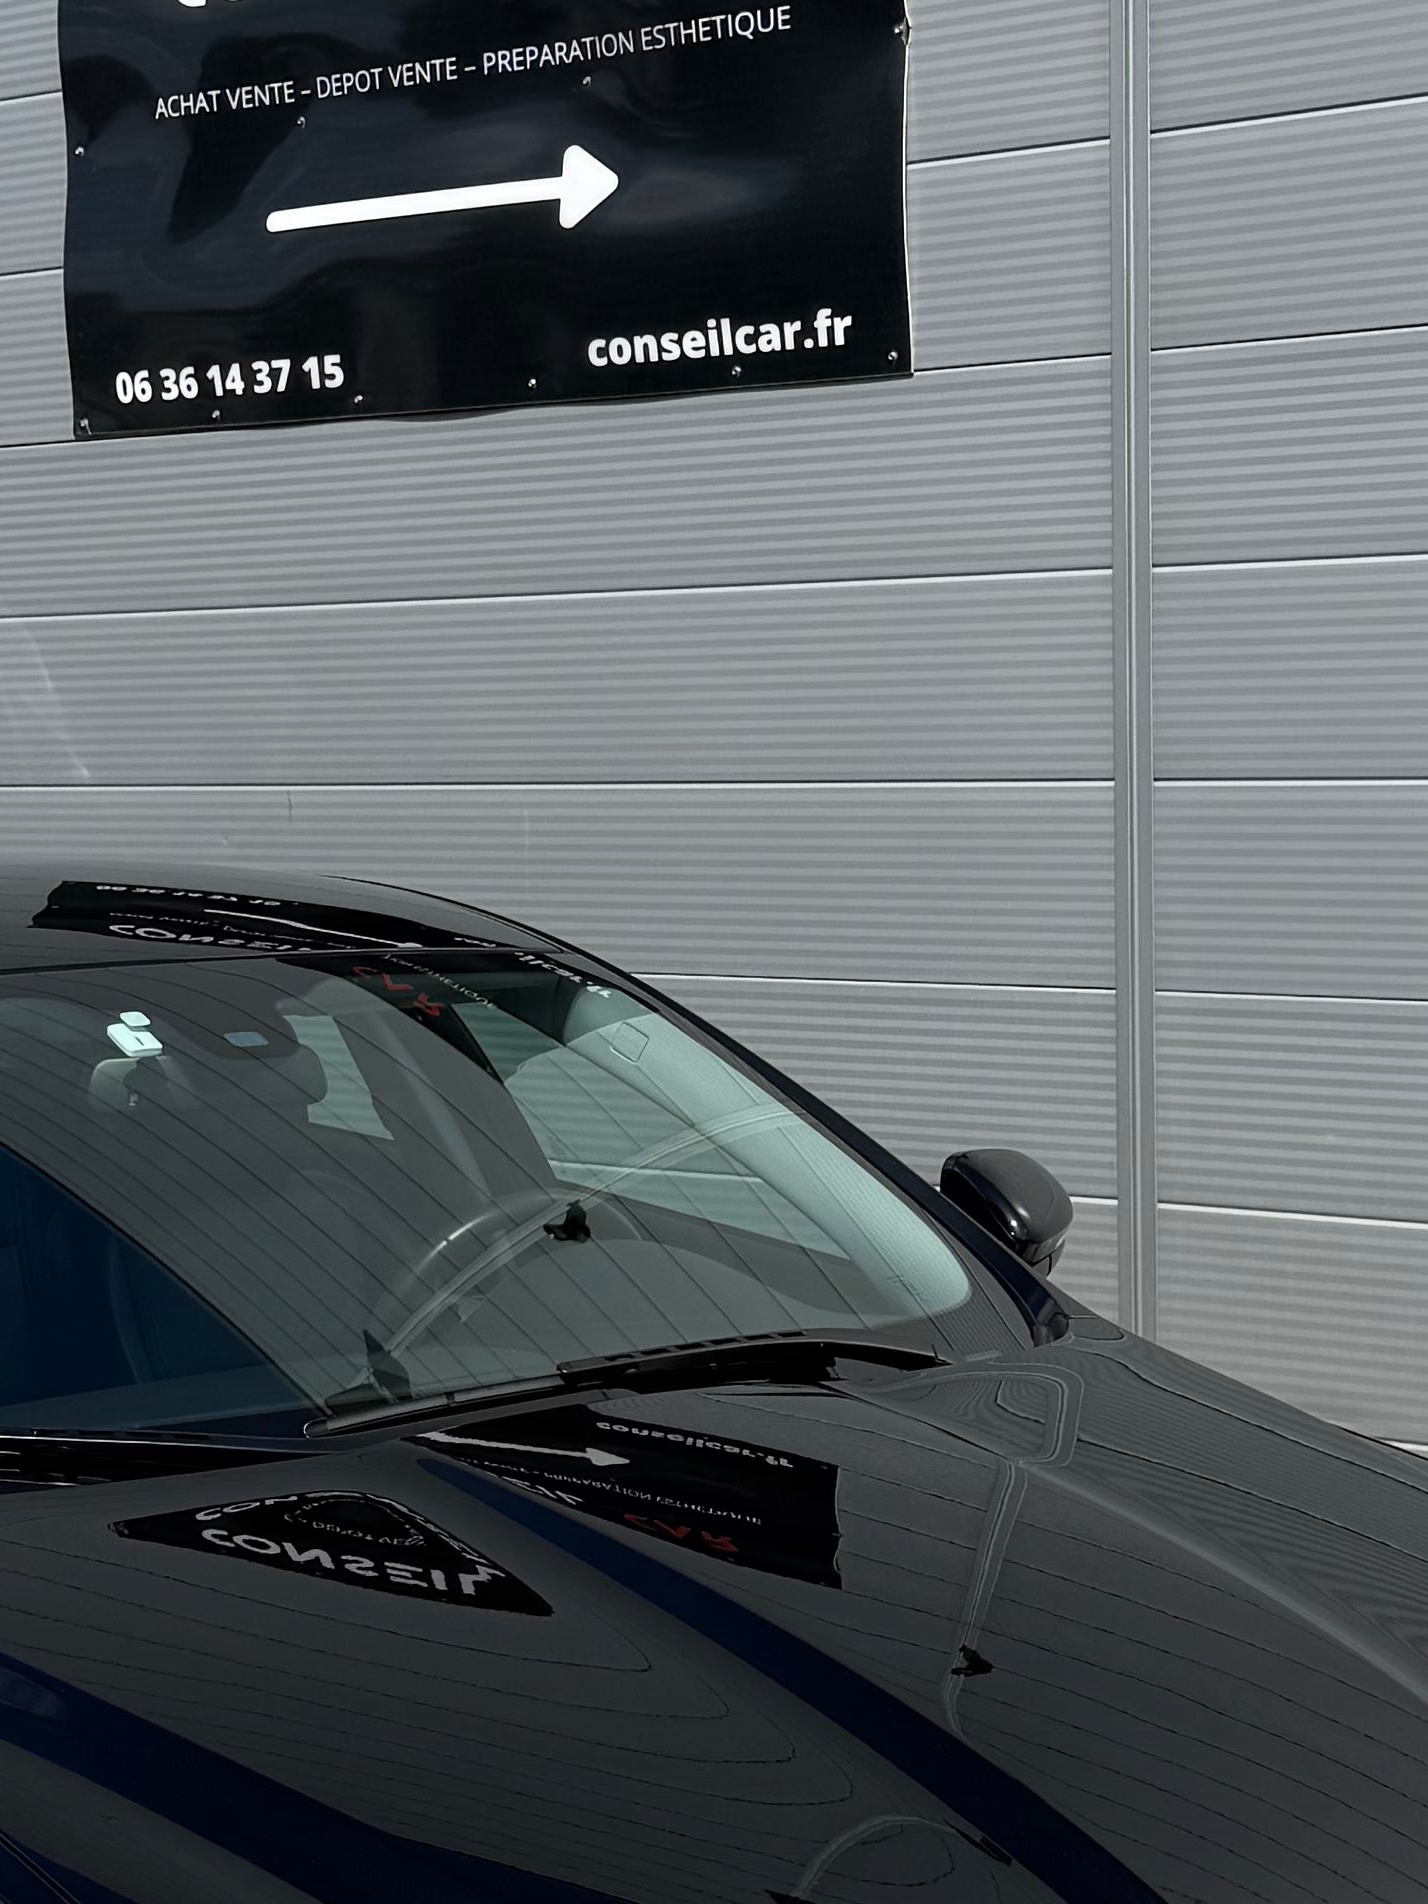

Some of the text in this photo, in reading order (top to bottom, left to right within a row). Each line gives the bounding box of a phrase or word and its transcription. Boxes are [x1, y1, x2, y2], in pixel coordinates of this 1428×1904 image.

[155, 89, 221, 120] ACHAT
[225, 80, 295, 110] VENTE
[316, 67, 383, 99] DEPOT
[387, 56, 458, 88] VENTE
[483, 30, 634, 76] PREPARATION
[640, 5, 791, 51] ESTHETIQUE
[587, 307, 852, 368] conseilcar.fr
[115, 354, 345, 404] 06 36 14 37 15
